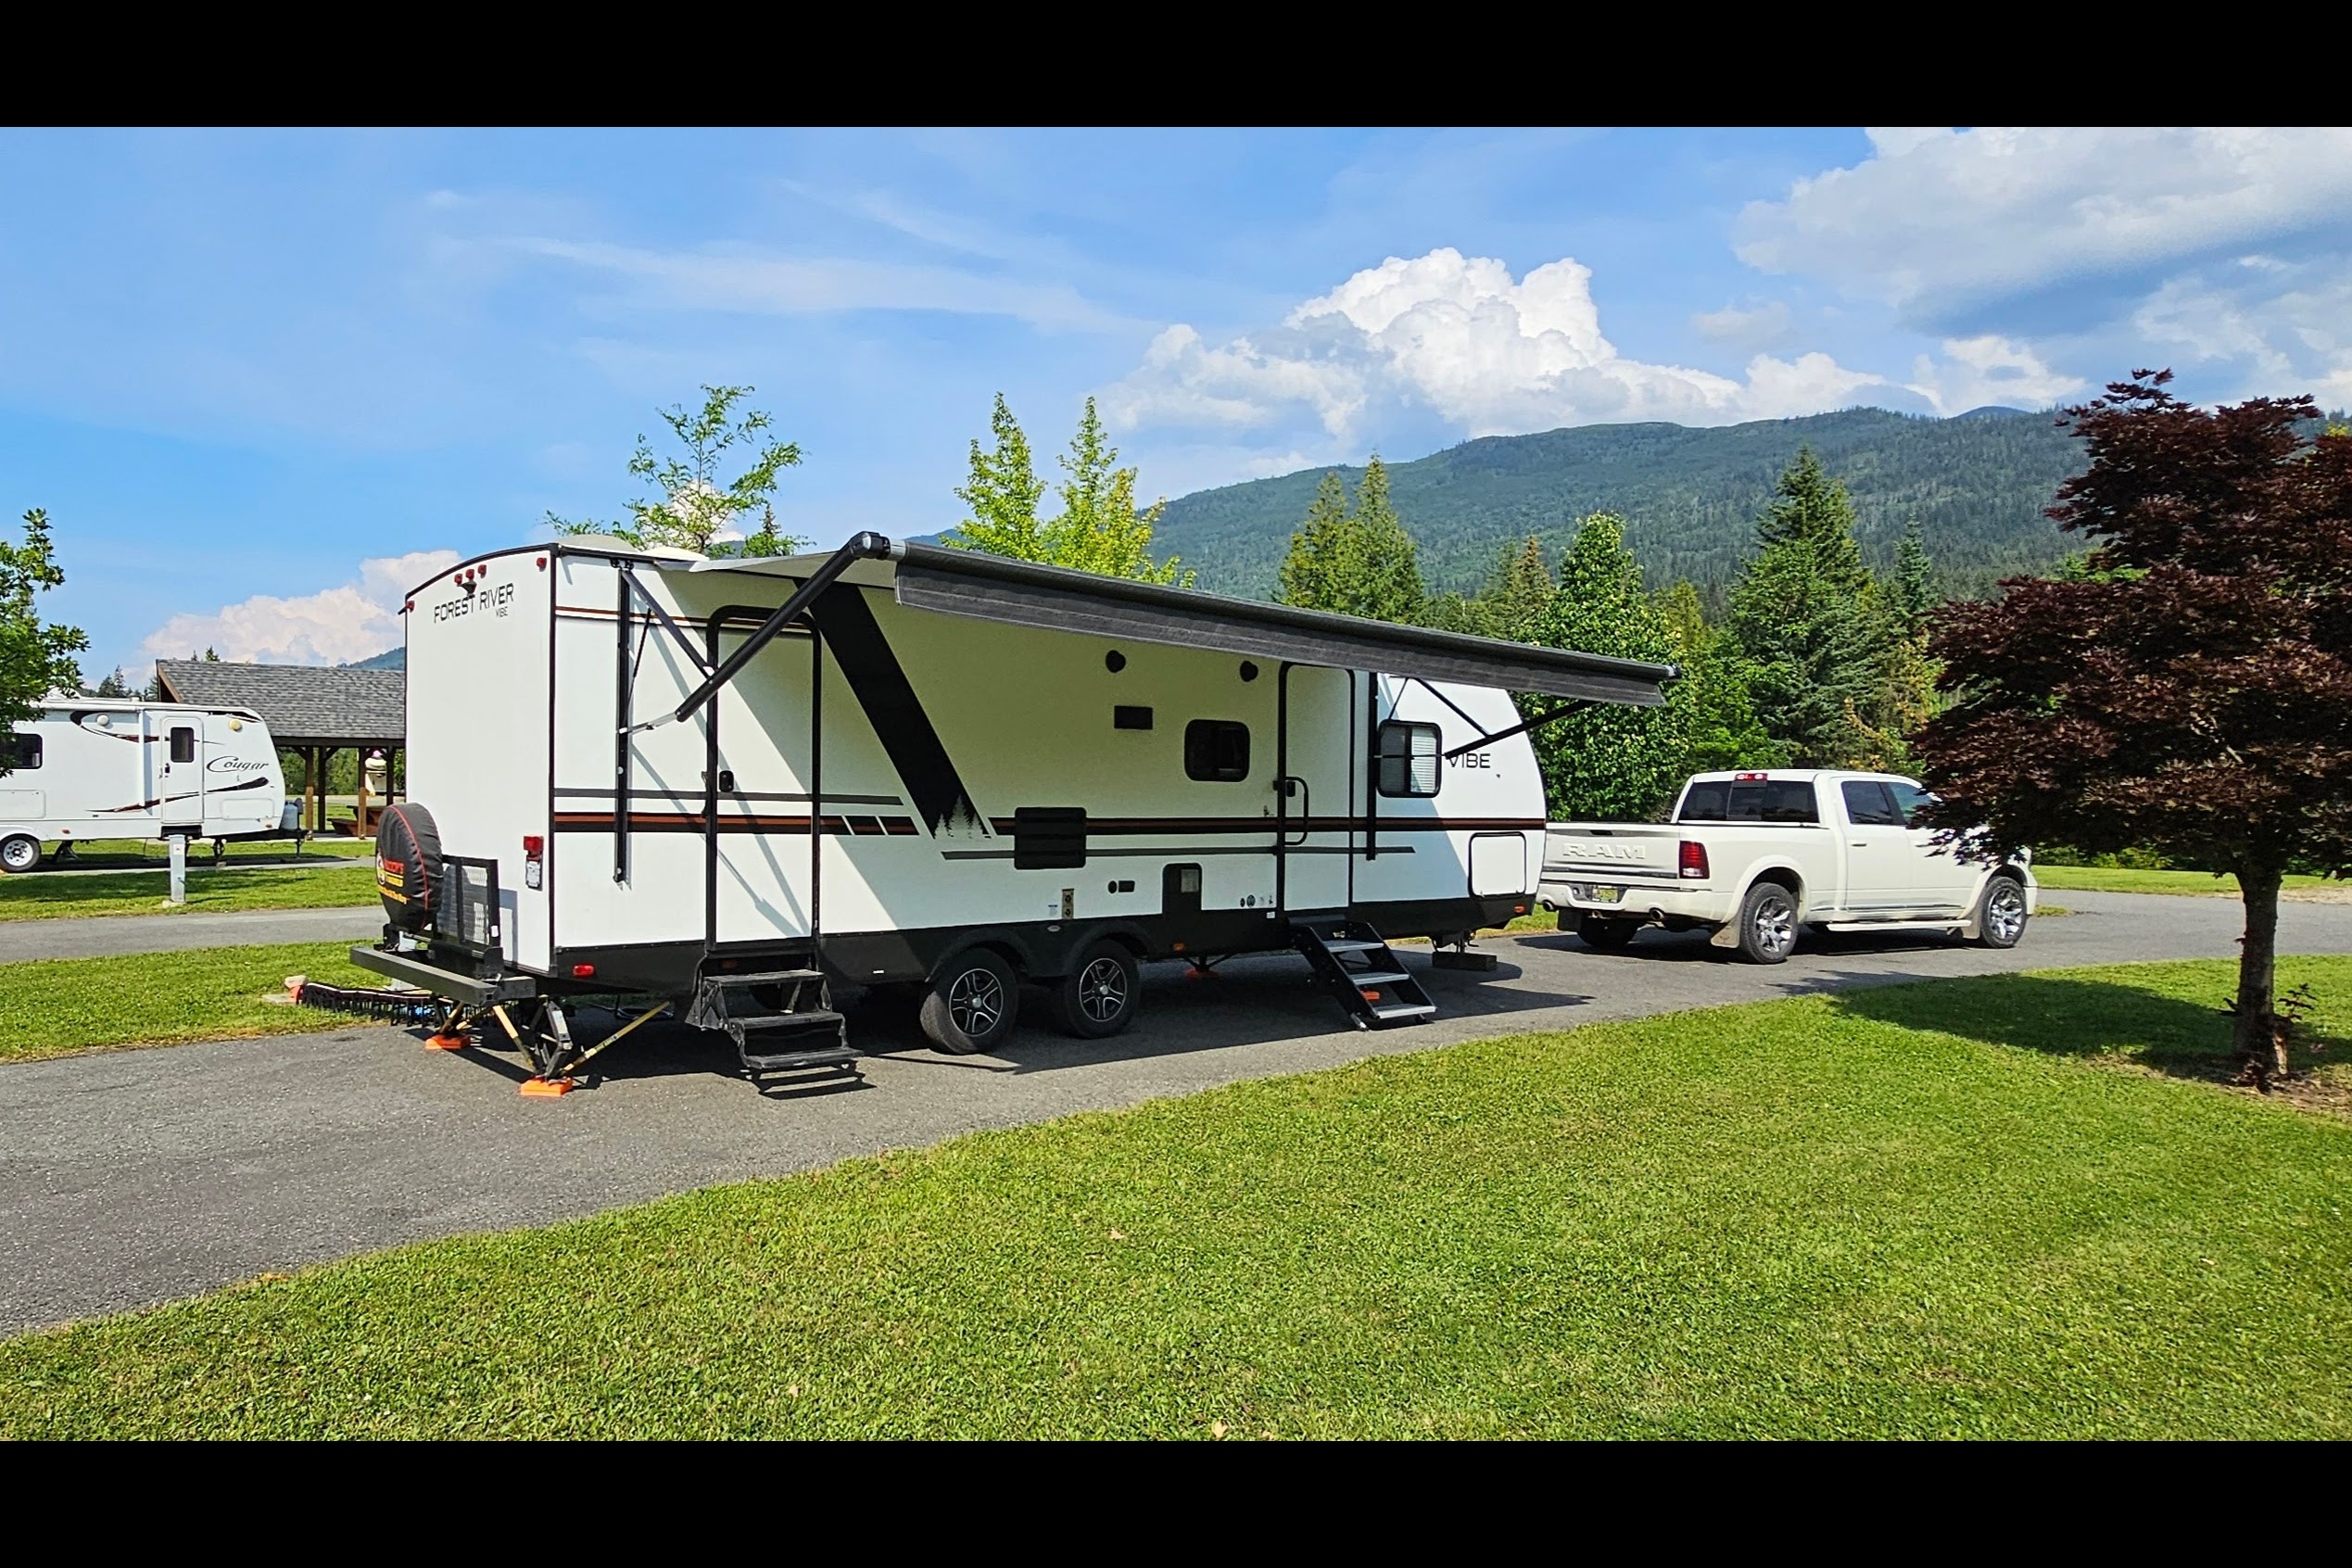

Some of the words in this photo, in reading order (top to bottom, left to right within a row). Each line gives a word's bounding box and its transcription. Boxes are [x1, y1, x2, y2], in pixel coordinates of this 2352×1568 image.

[433, 593, 475, 624] FOREST
[479, 582, 514, 611] RIVER
[206, 755, 270, 773] Cougar
[1448, 752, 1491, 769] VIBE
[1562, 842, 1647, 860] RAM
